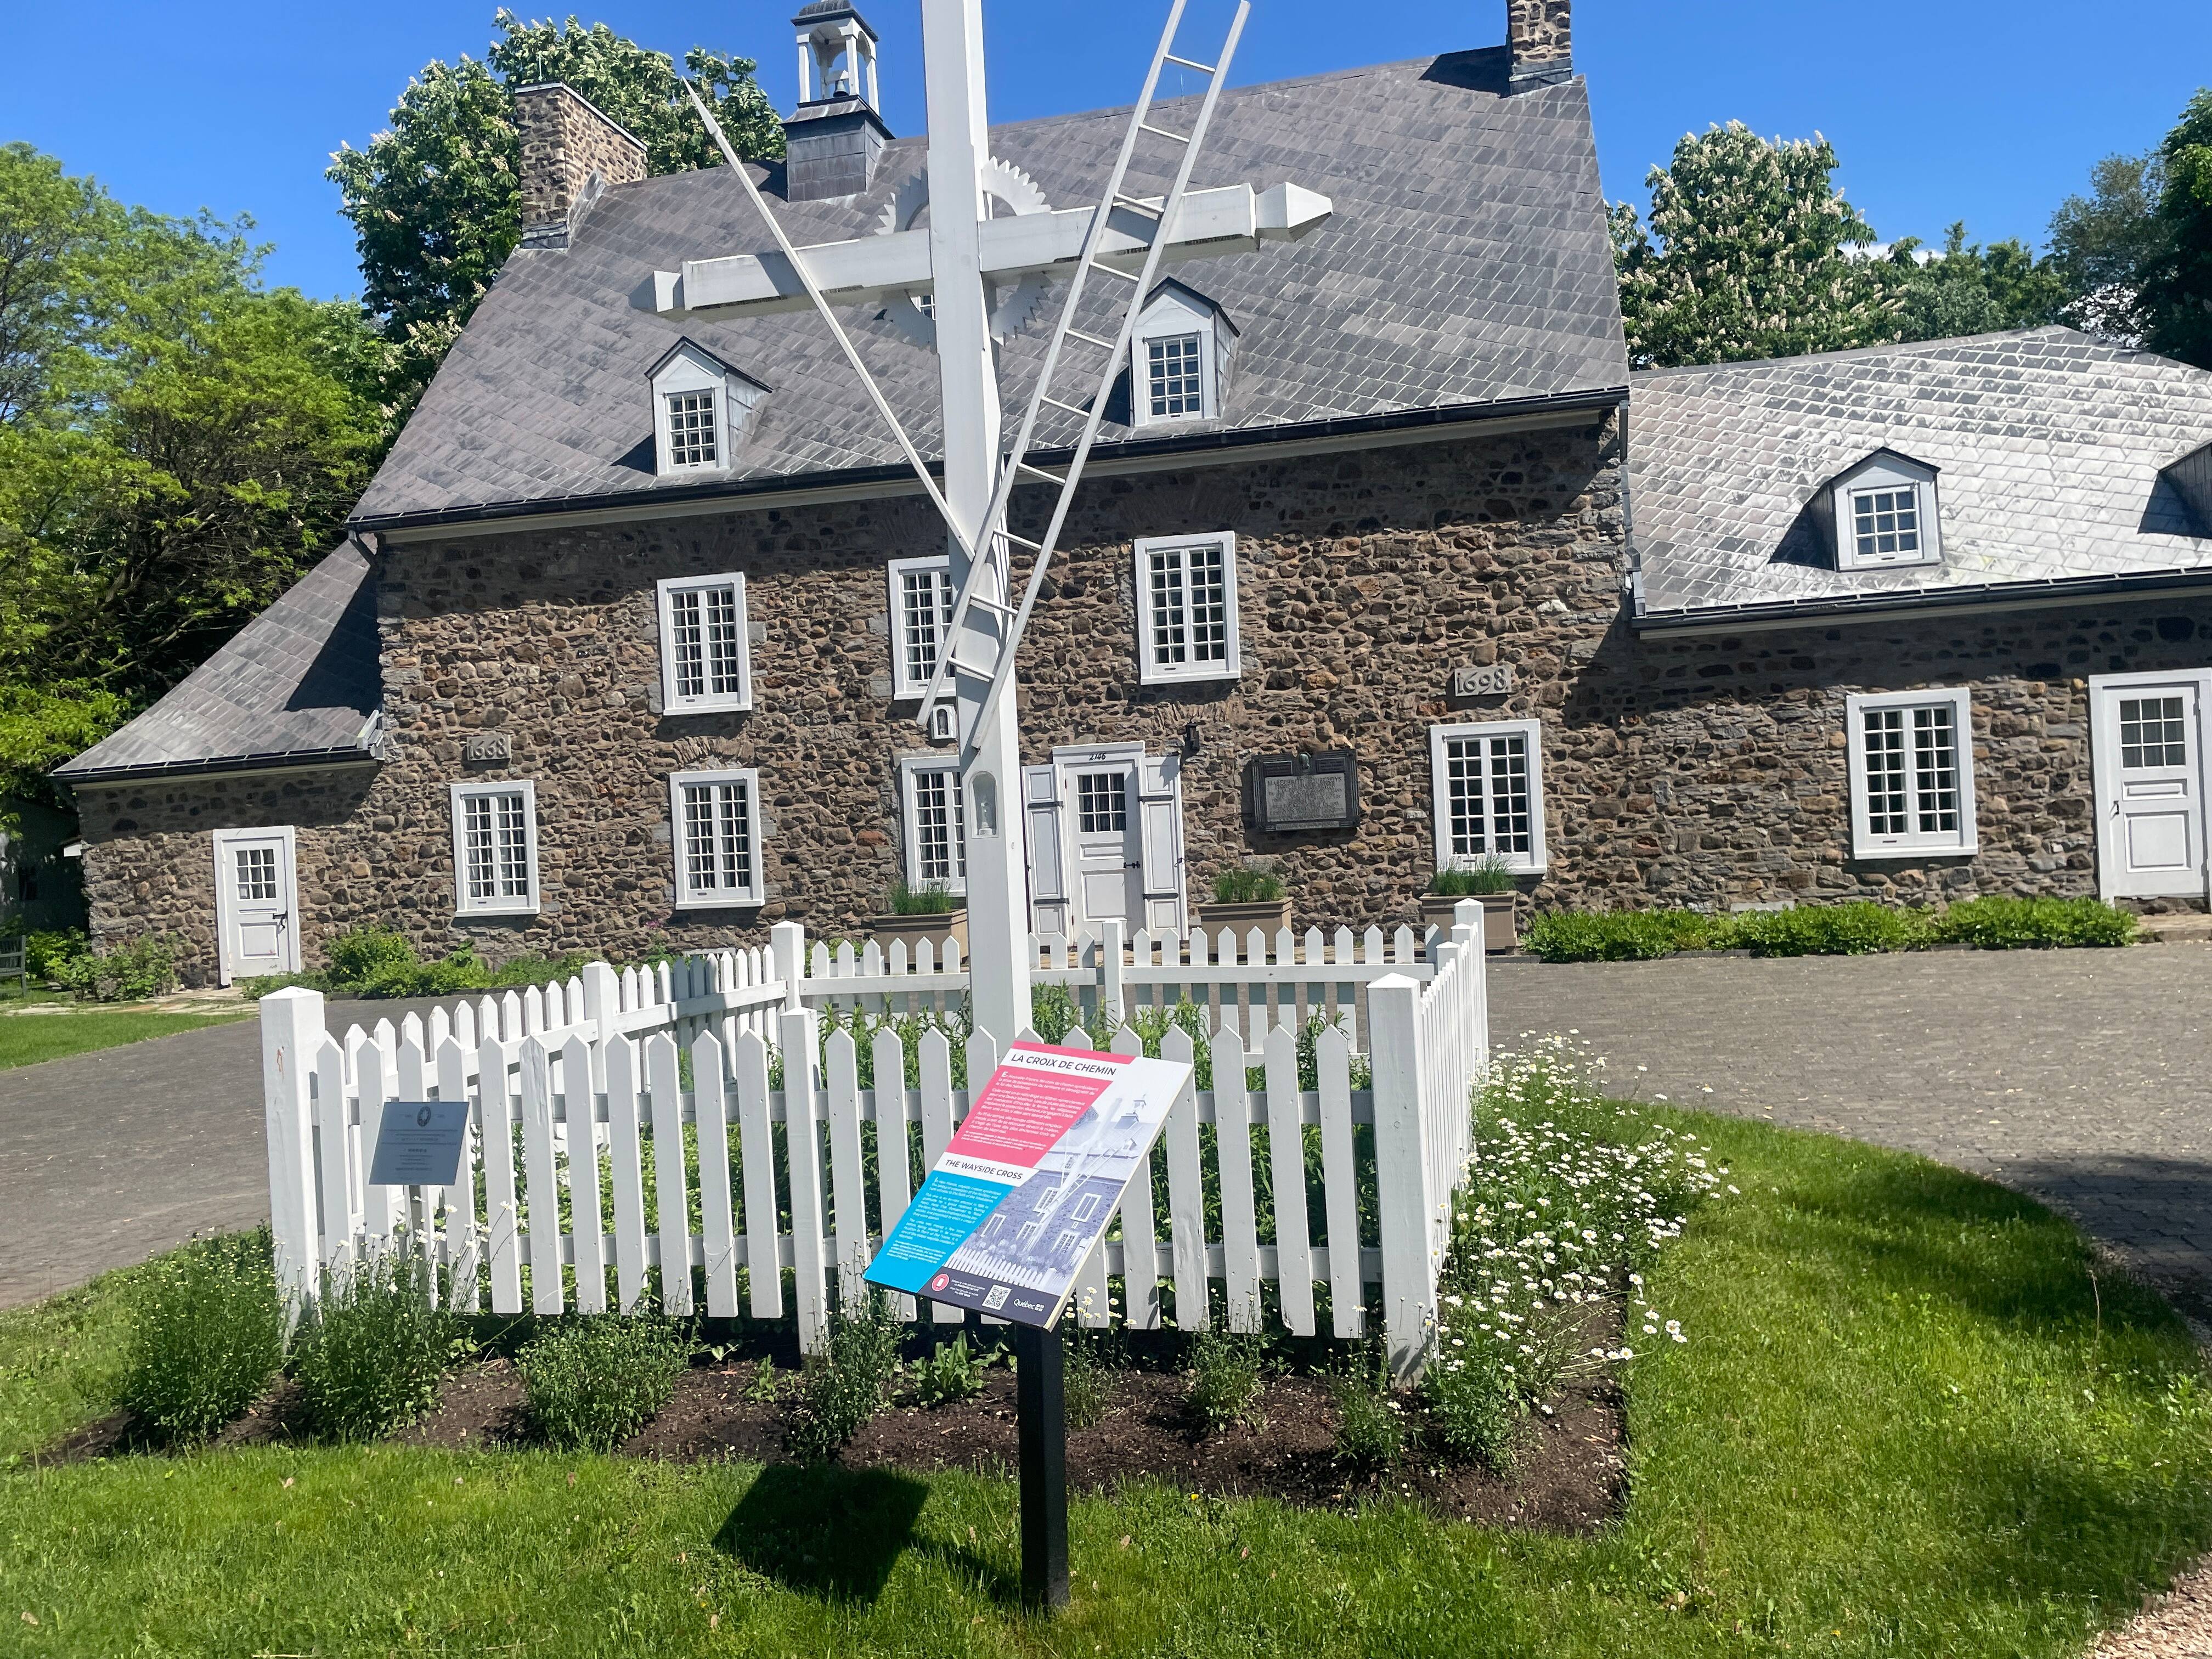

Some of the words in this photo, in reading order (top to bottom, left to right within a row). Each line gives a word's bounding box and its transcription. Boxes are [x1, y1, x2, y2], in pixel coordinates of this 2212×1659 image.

[1457, 668, 1507, 694] 1698
[469, 737, 507, 759] 1668
[1089, 752, 1106, 761] 2146
[1011, 1054, 1024, 1063] LA
[1026, 1056, 1058, 1067] CROIX
[1058, 1060, 1074, 1069] DE
[1075, 1063, 1117, 1075] CHEMIN
[945, 1159, 961, 1167] THE
[961, 1162, 996, 1175] WAYSIDE
[996, 1169, 1023, 1180] CROSS
[1013, 1299, 1036, 1310] Québec
